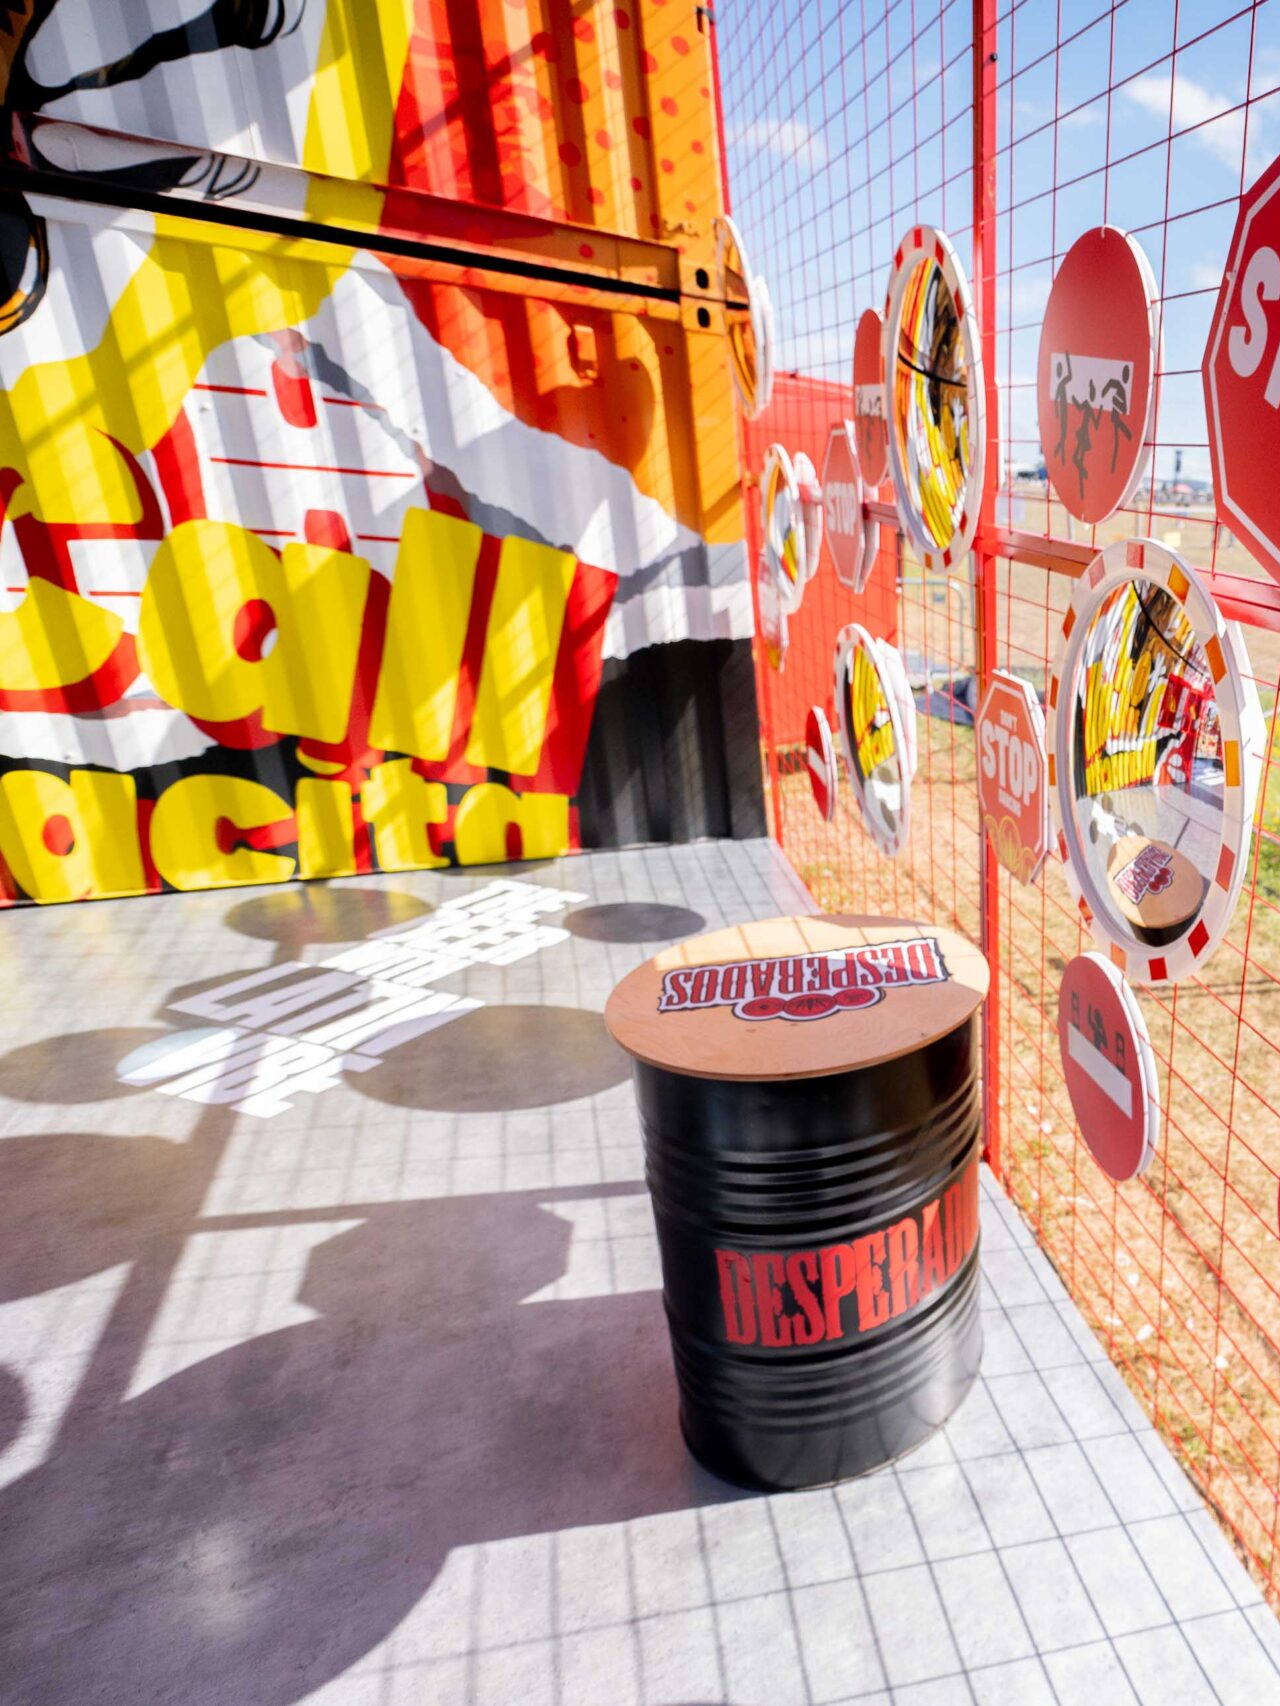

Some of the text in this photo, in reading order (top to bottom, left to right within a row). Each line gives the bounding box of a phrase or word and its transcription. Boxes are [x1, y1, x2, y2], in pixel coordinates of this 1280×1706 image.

[981, 719, 1038, 806] STOP
[166, 959, 487, 1058] LATIN
[664, 940, 940, 1008] DESPERADOS
